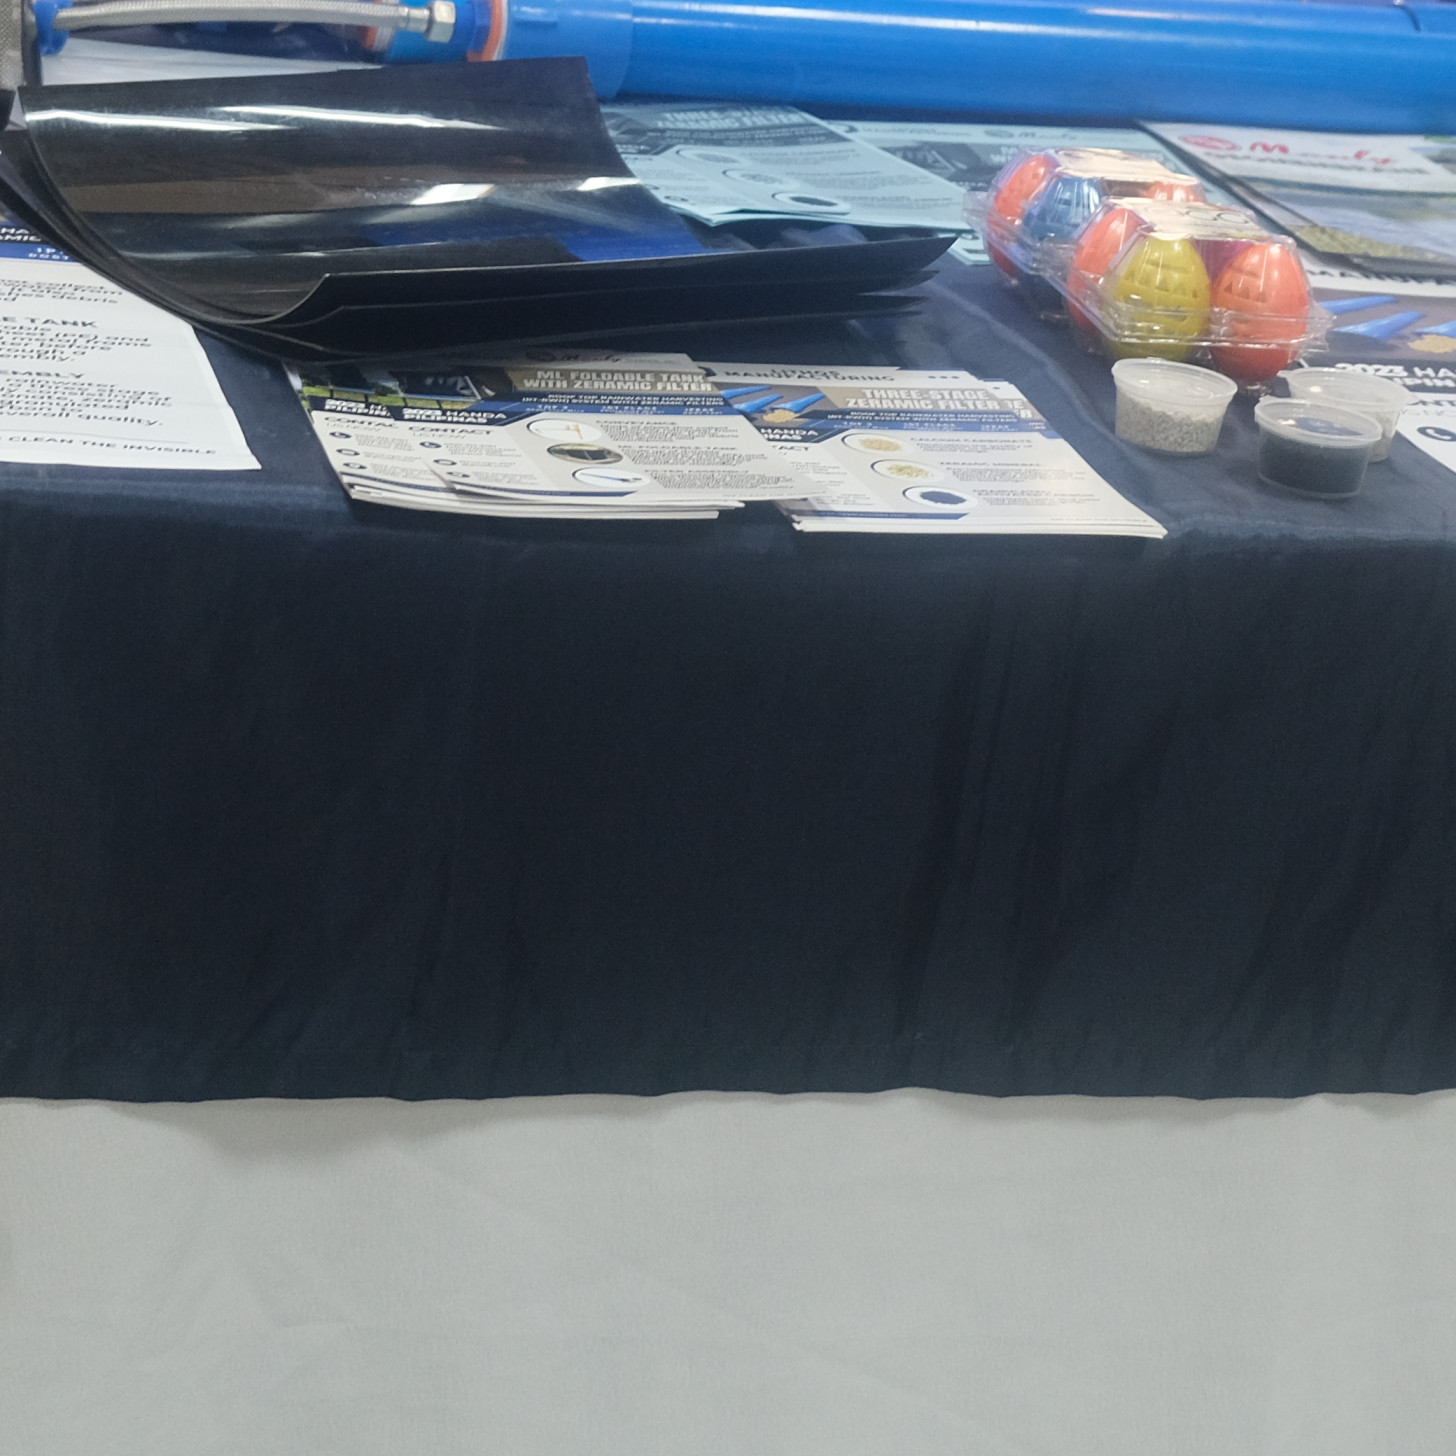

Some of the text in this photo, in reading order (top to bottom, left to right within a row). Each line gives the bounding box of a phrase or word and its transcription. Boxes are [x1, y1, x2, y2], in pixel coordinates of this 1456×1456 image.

[536, 371, 704, 383] ML FOLDABLE TANK
[523, 379, 712, 391] WITH ZERAMIC FILTER
[862, 388, 989, 400] THREE-STAGE
[846, 398, 1000, 410] ZERAMIC FILTER
